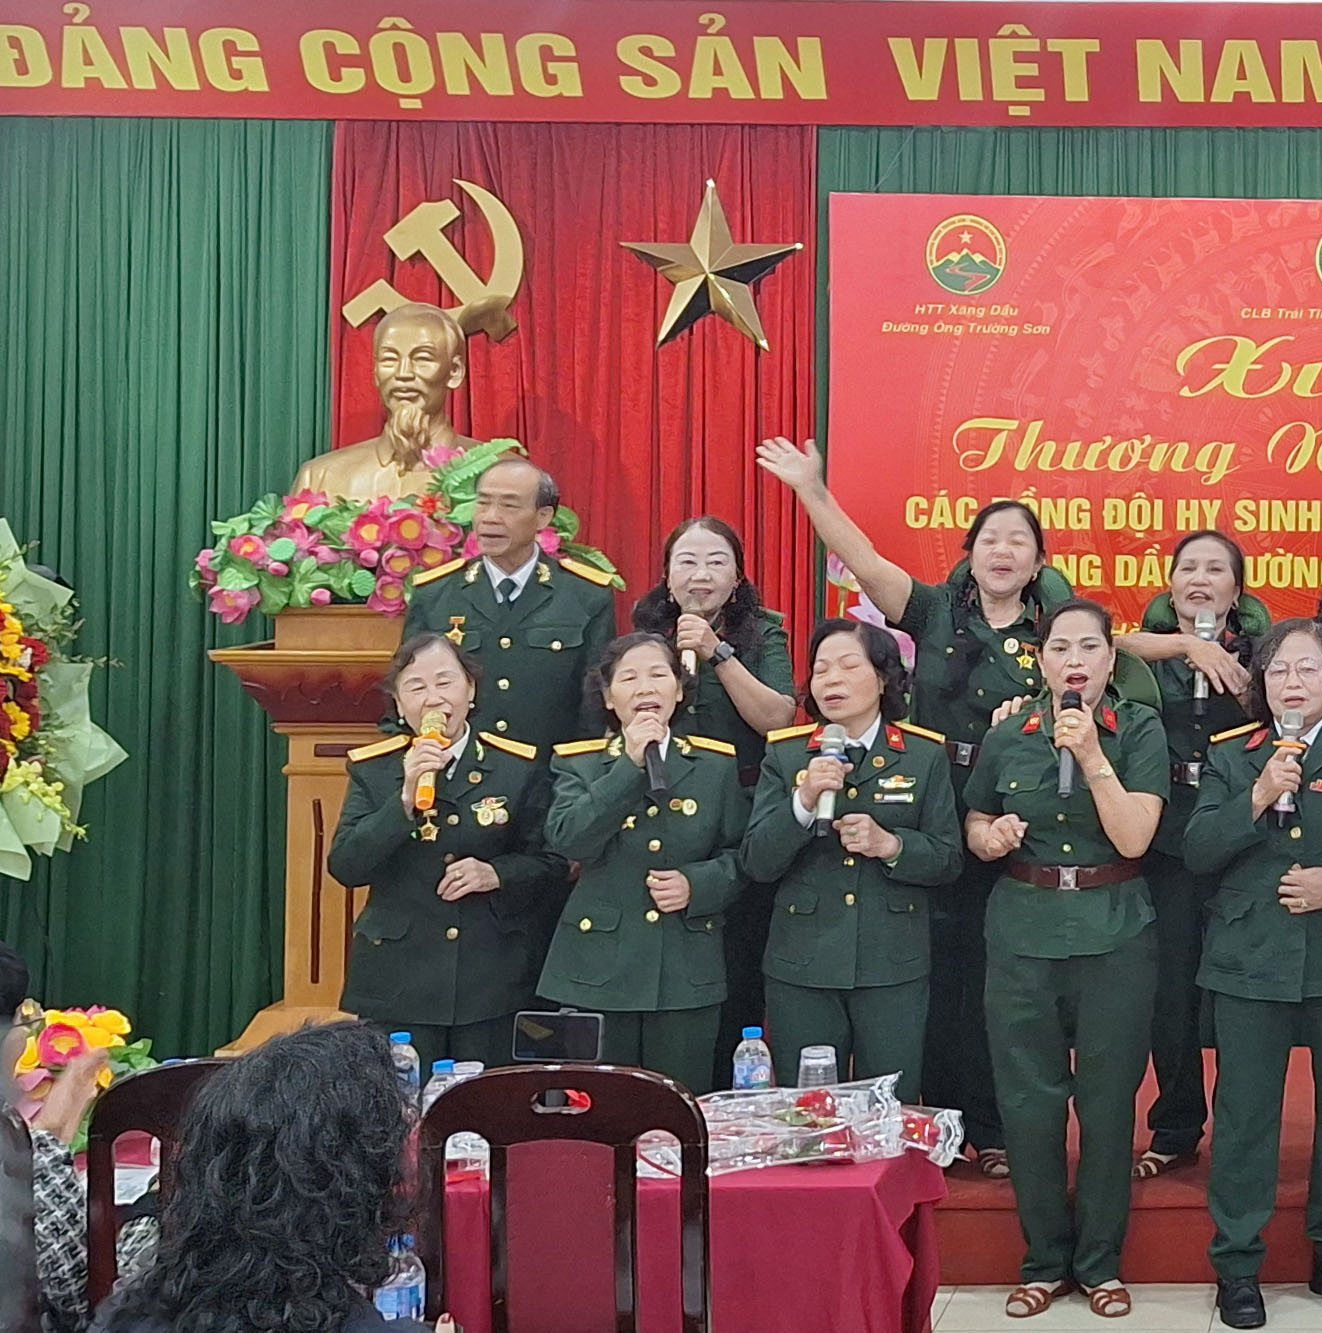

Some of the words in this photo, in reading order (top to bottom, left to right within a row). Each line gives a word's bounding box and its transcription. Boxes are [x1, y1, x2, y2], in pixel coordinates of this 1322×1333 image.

[0, 2, 270, 92] ĐẢNG
[300, 17, 583, 108] CỘNG
[616, 12, 828, 99] SẢN
[886, 24, 1100, 115] VIỆT
[914, 303, 944, 315] HTT
[1241, 307, 1271, 319] CLB
[1022, 322, 1051, 335] Sơn
[952, 417, 1240, 486] Thương
[905, 489, 979, 529] CÁC
[1103, 491, 1163, 538] ĐỘI
[1176, 498, 1223, 531] HY
[1233, 498, 1322, 533] SINH
